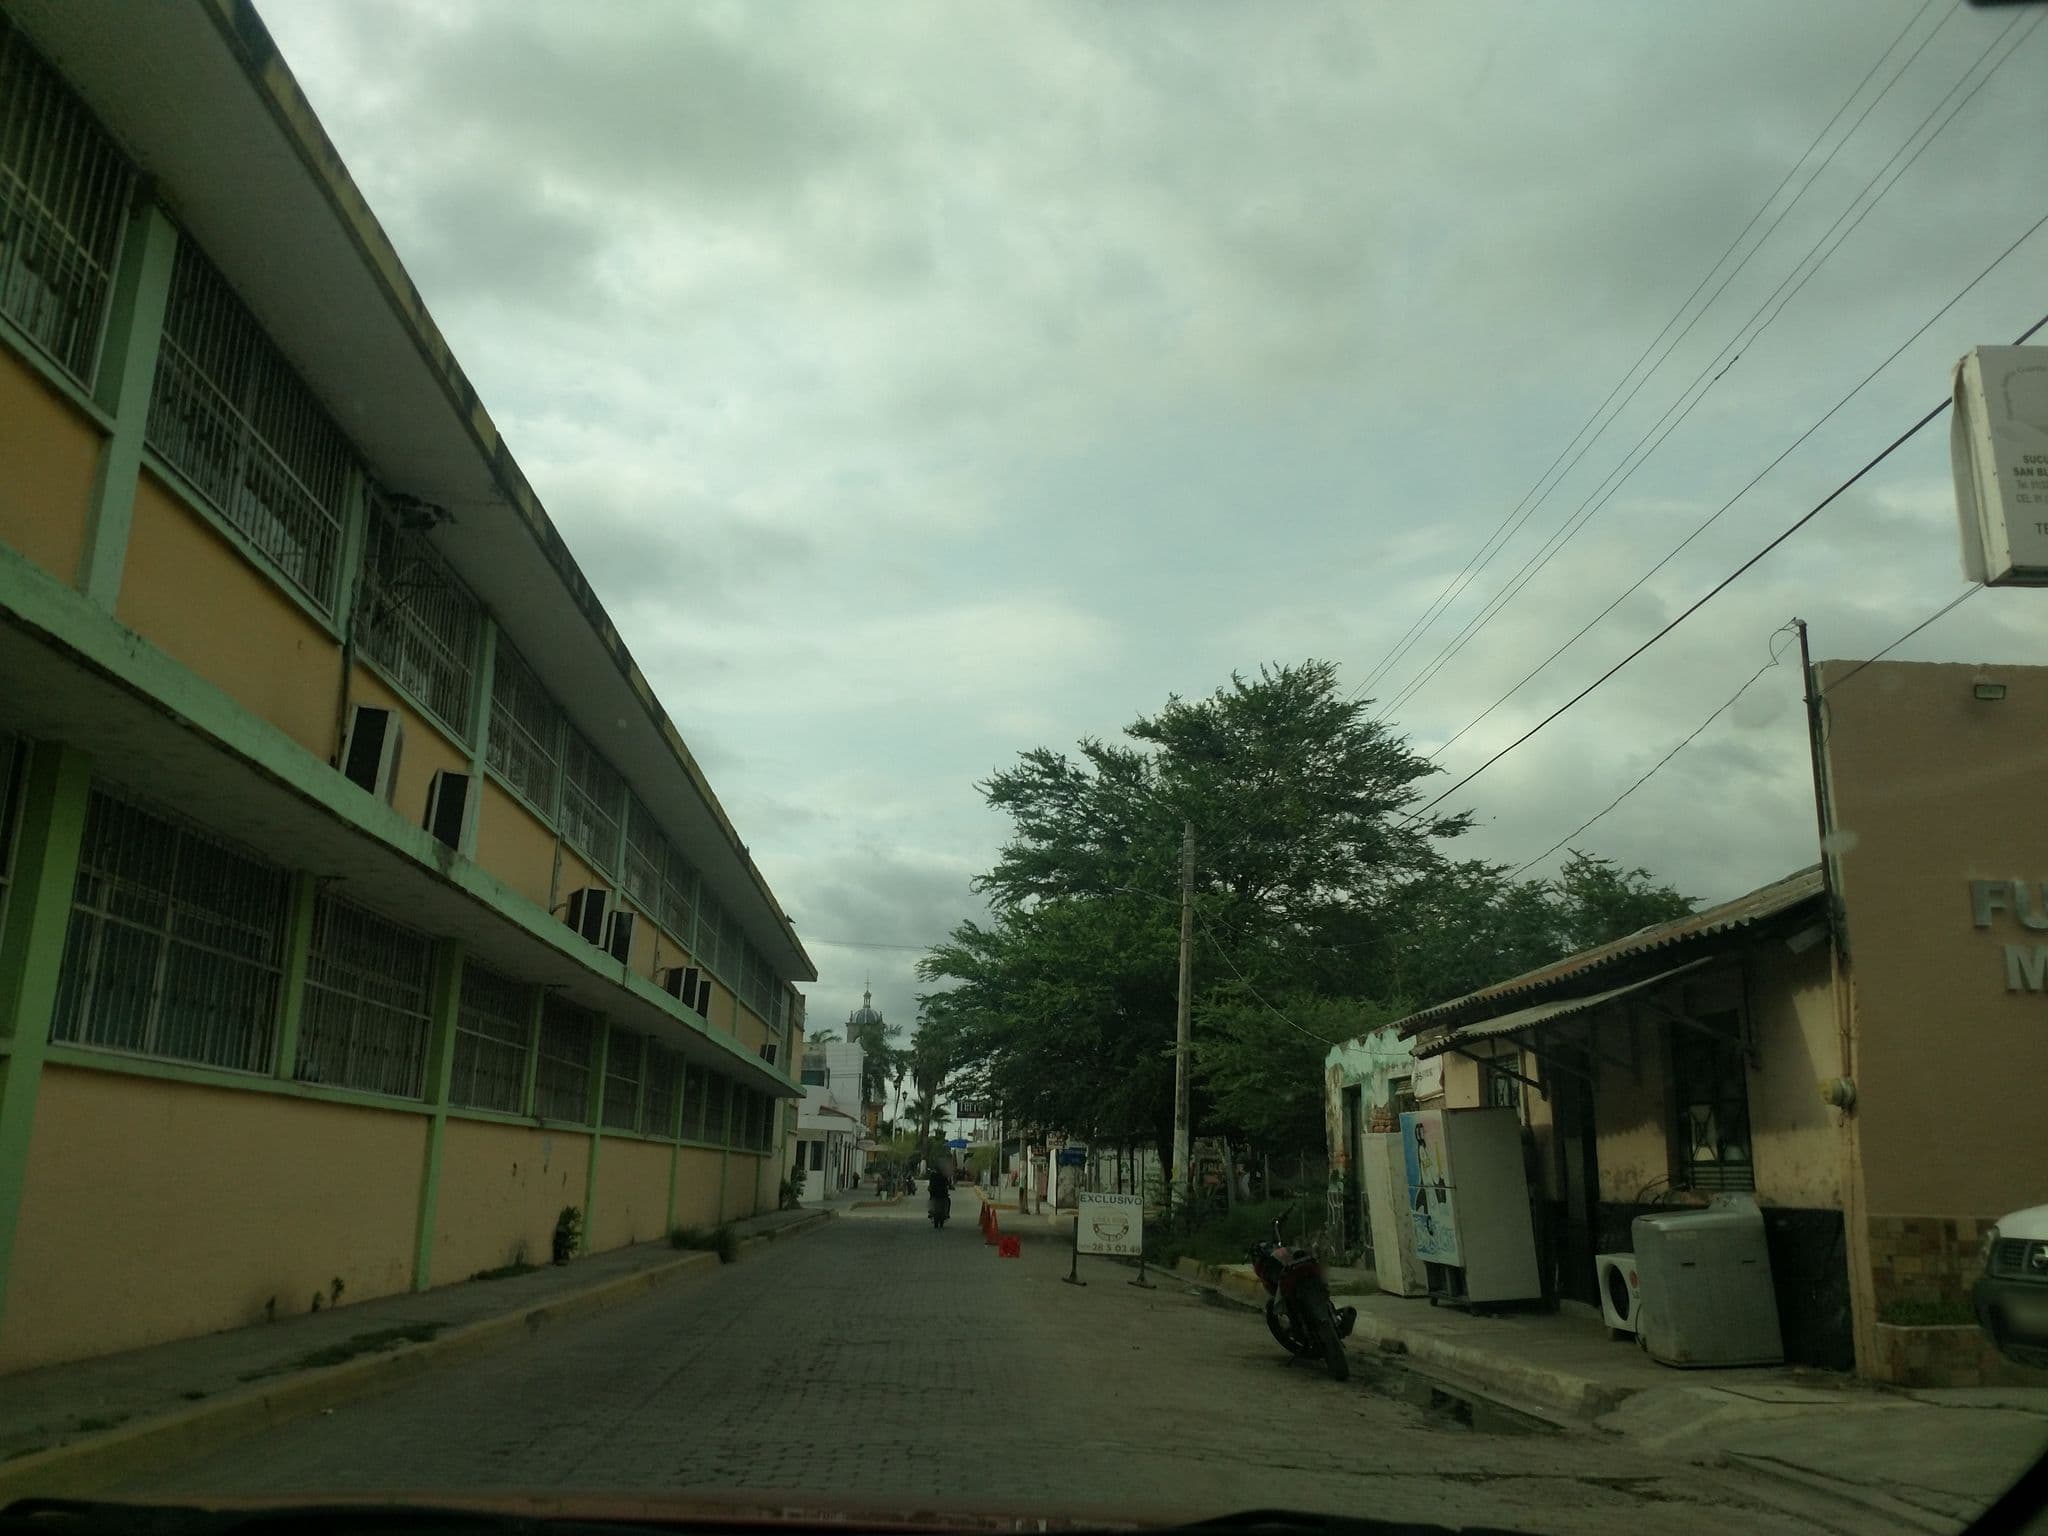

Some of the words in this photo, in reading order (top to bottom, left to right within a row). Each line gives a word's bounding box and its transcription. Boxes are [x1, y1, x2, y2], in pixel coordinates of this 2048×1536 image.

[2013, 467, 2034, 477] SAN
[2034, 522, 2048, 535] TE
[1969, 880, 2048, 929] FU
[1080, 1193, 1143, 1206] EXCLUSIVO
